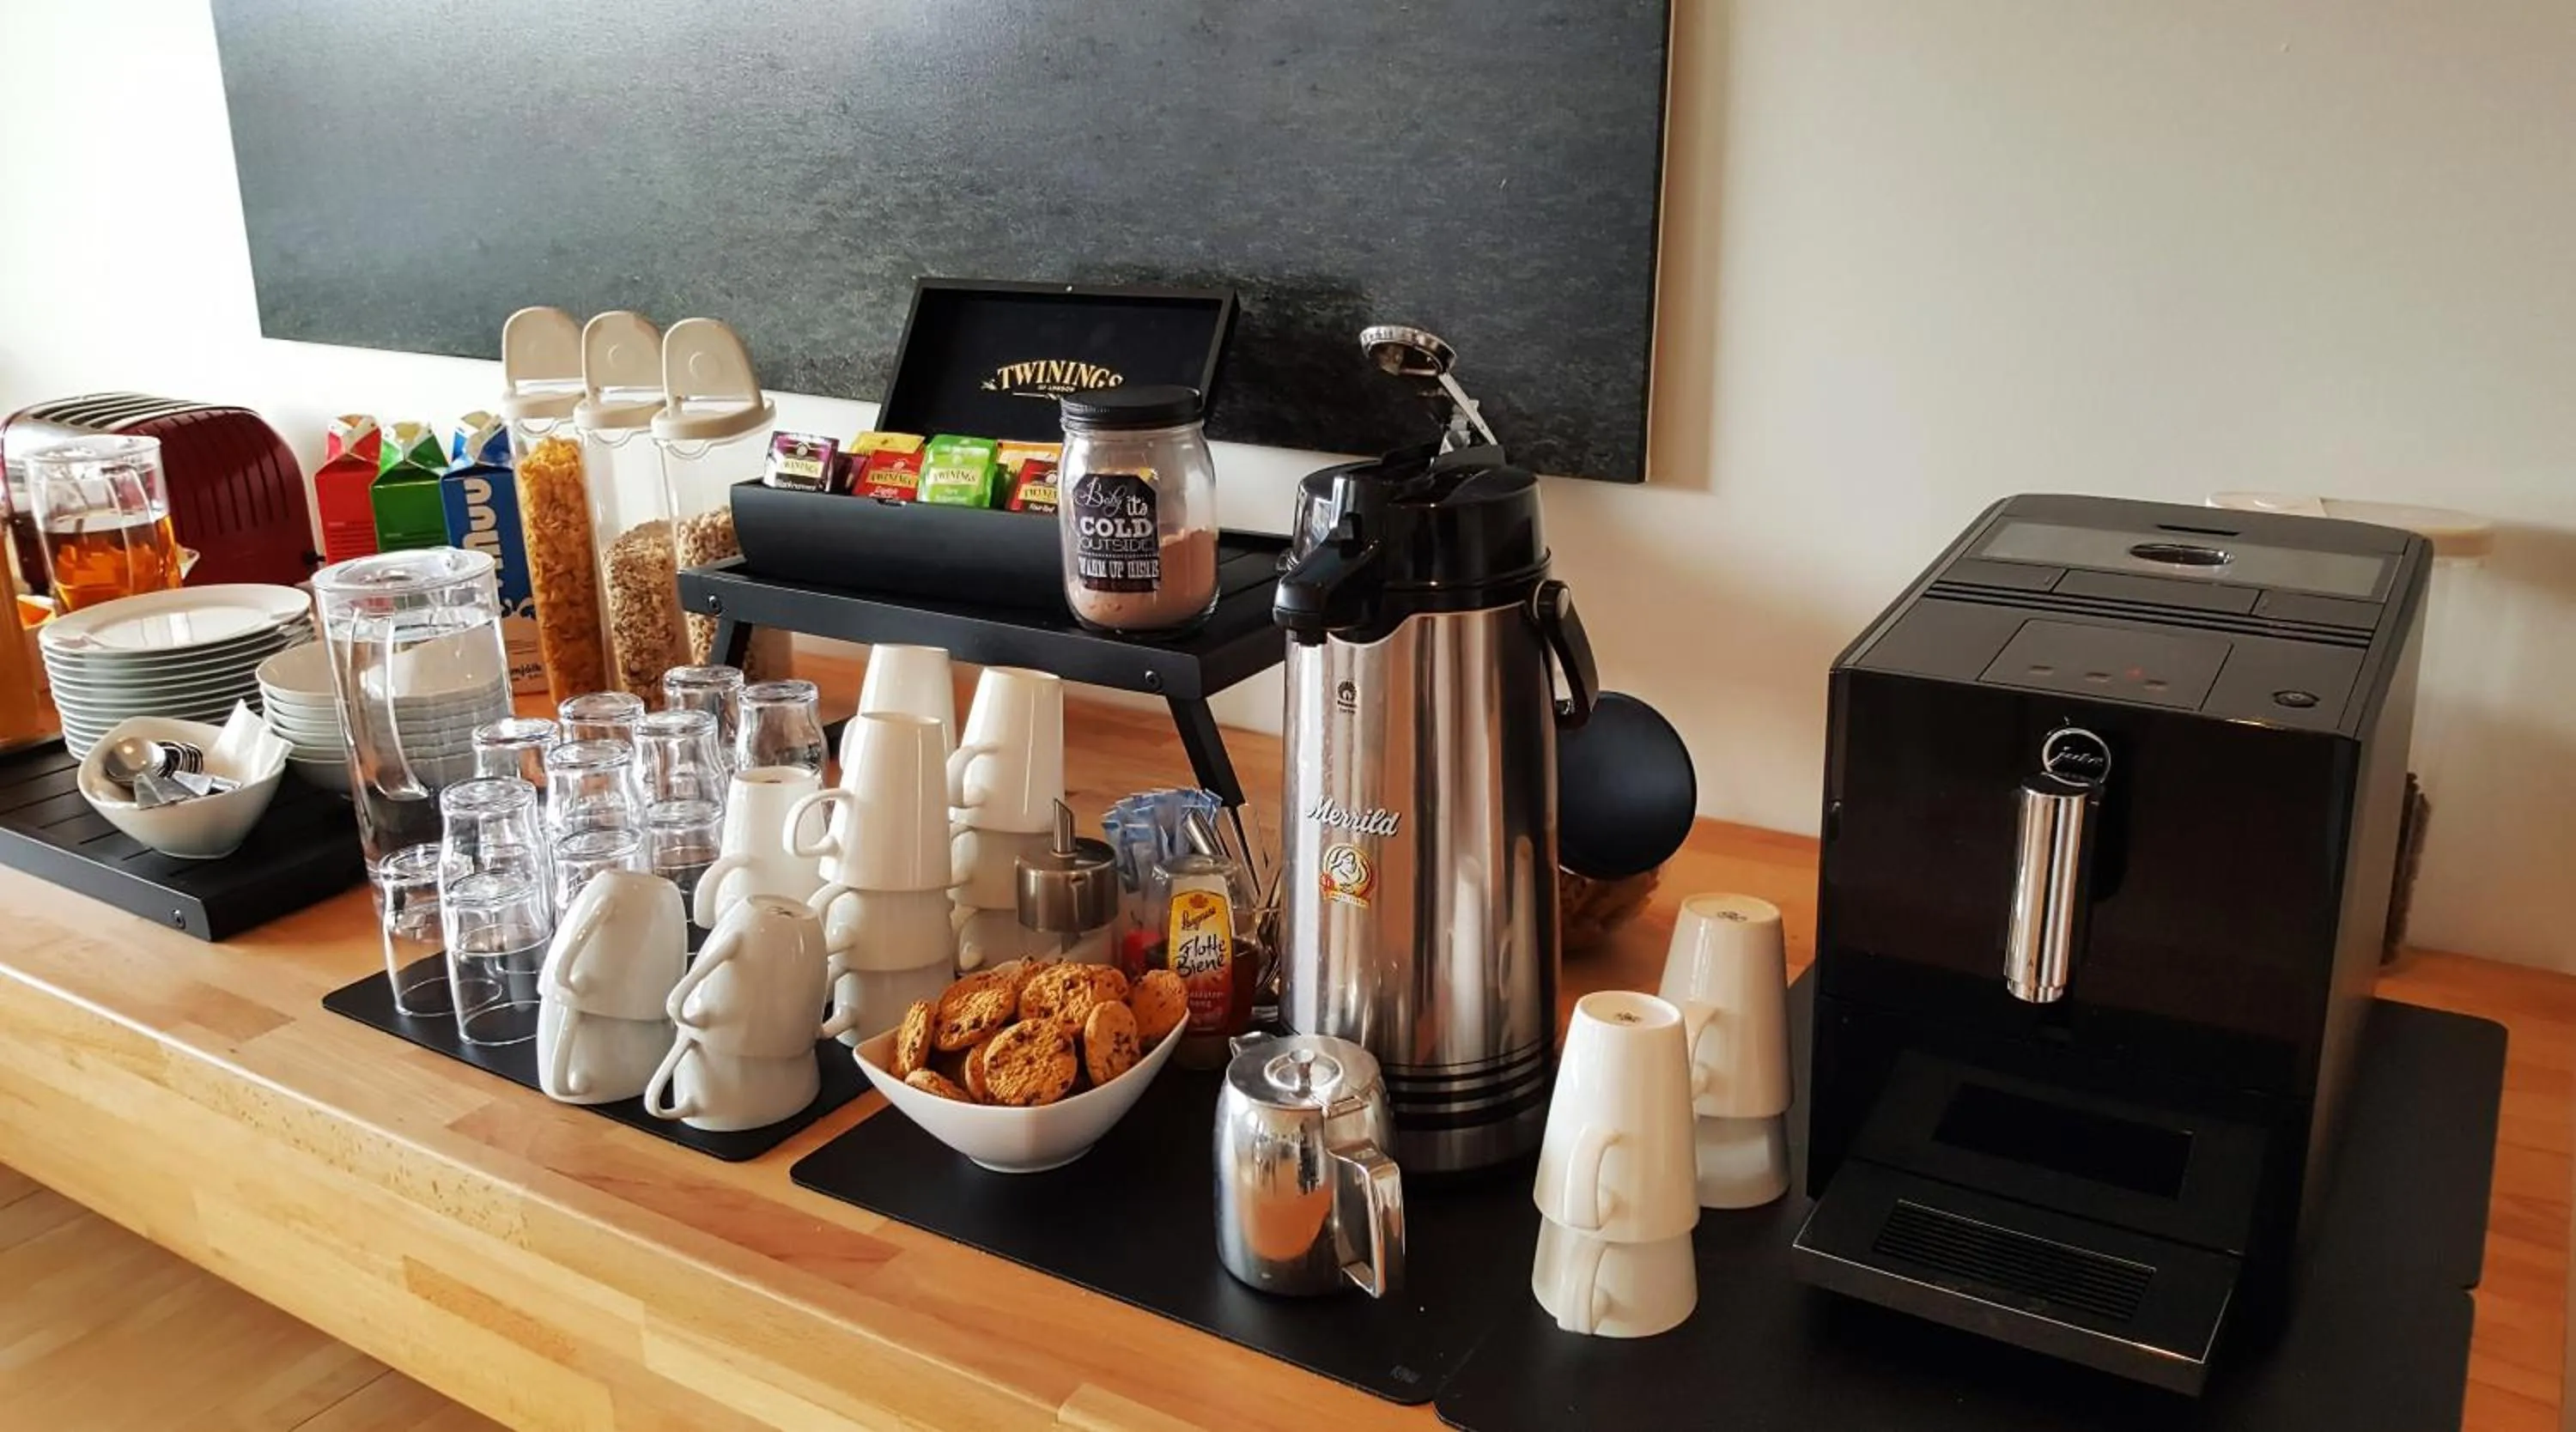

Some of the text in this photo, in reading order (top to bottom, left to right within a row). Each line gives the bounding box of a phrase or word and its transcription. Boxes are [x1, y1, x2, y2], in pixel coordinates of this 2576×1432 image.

[997, 360, 1124, 390] TWININGS
[1024, 488, 1057, 500] TWINI
[1073, 476, 1127, 517] Baby
[1079, 516, 1152, 538] COLD
[1306, 794, 1401, 837] Merrild
[1180, 933, 1226, 959] Flotte
[1174, 953, 1225, 978] Biene
